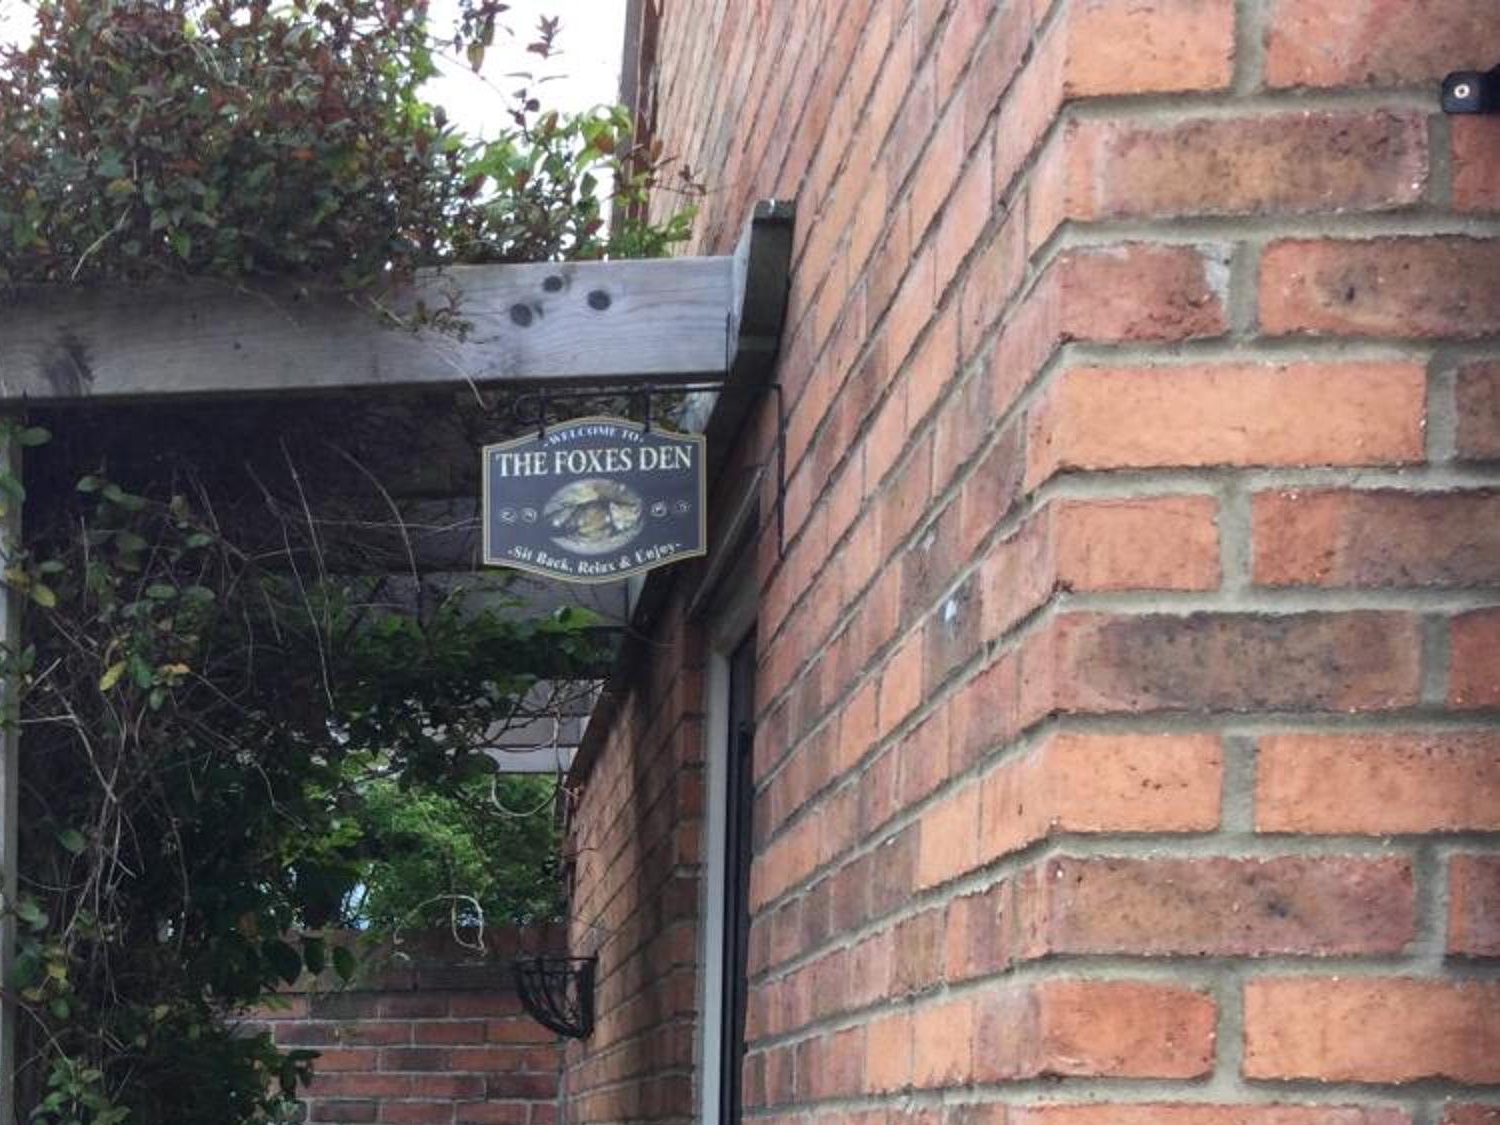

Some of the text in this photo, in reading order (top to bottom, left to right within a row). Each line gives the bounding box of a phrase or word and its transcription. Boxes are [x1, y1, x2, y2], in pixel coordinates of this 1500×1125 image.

[495, 445, 693, 478] THE FOXES DEN
[536, 550, 573, 573] Back,
[578, 559, 616, 575] Relax
[619, 555, 632, 569] &
